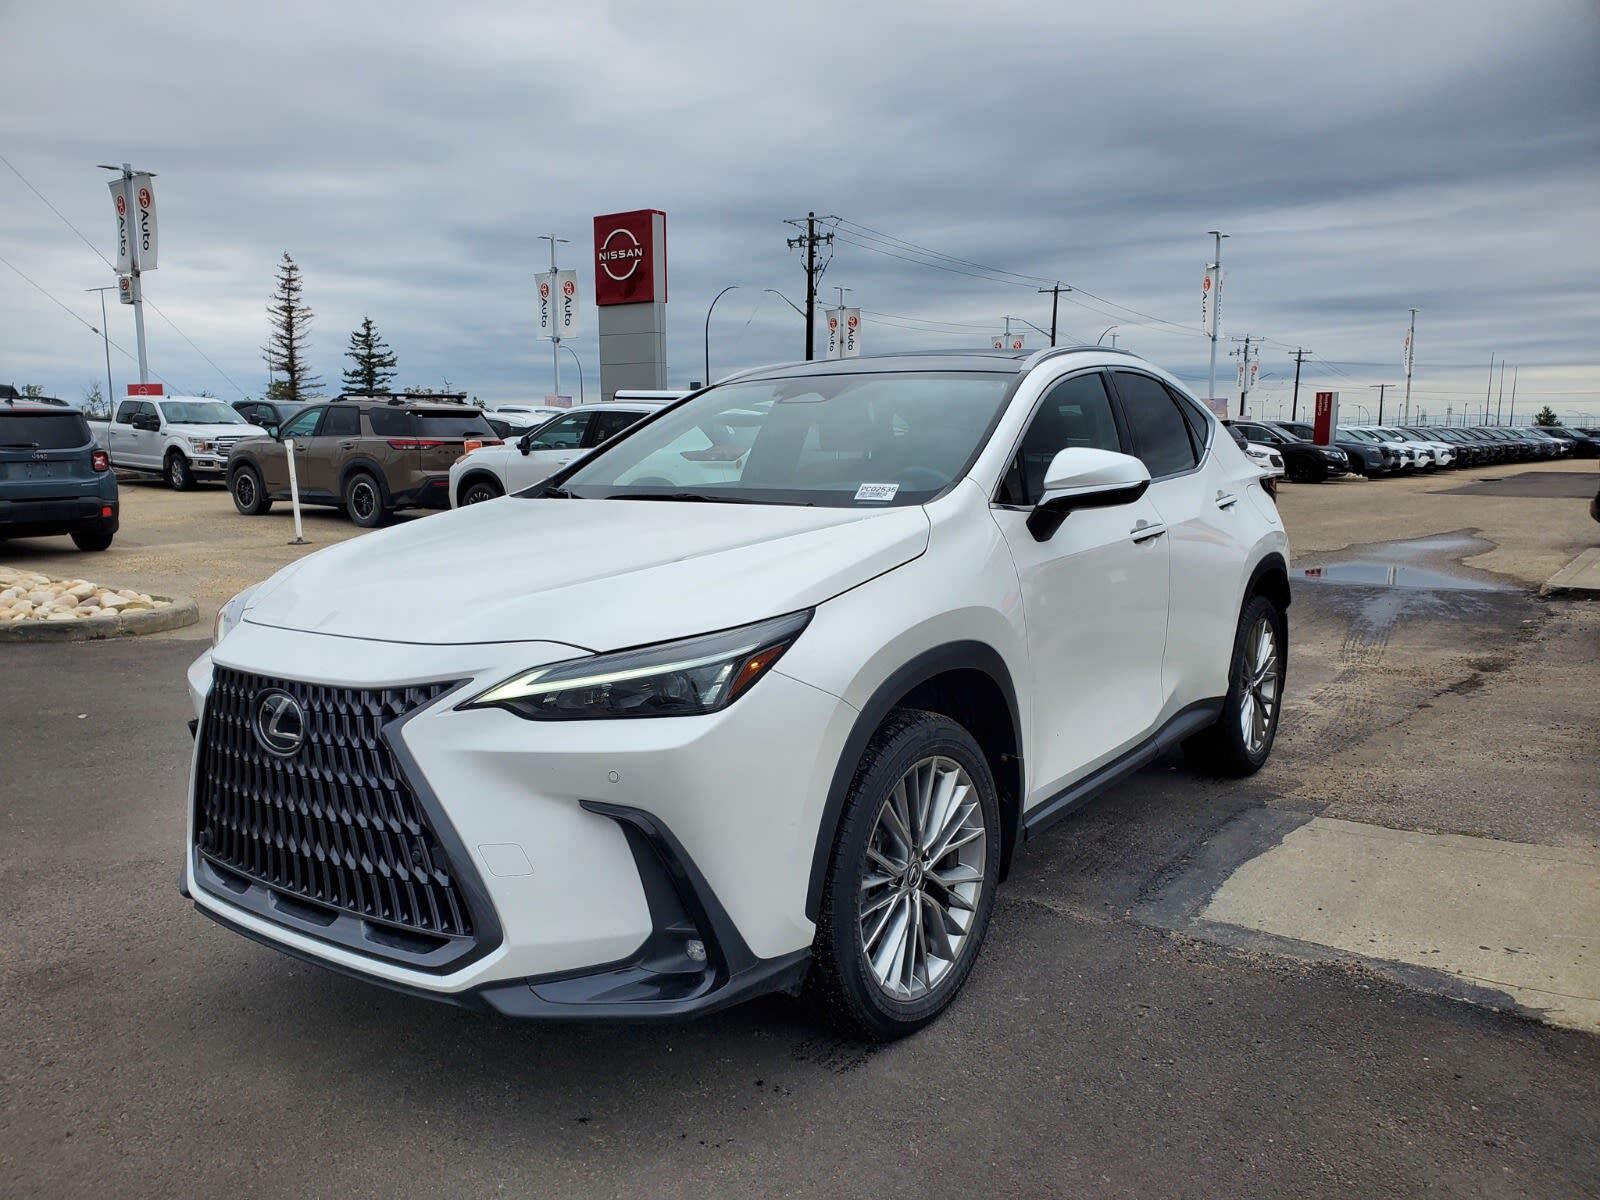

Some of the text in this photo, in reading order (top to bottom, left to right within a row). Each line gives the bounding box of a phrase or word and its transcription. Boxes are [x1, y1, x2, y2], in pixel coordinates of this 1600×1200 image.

[119, 216, 127, 257] Auto
[140, 208, 151, 251] Auto
[599, 248, 643, 261] NISSAN
[564, 296, 573, 327] Auto
